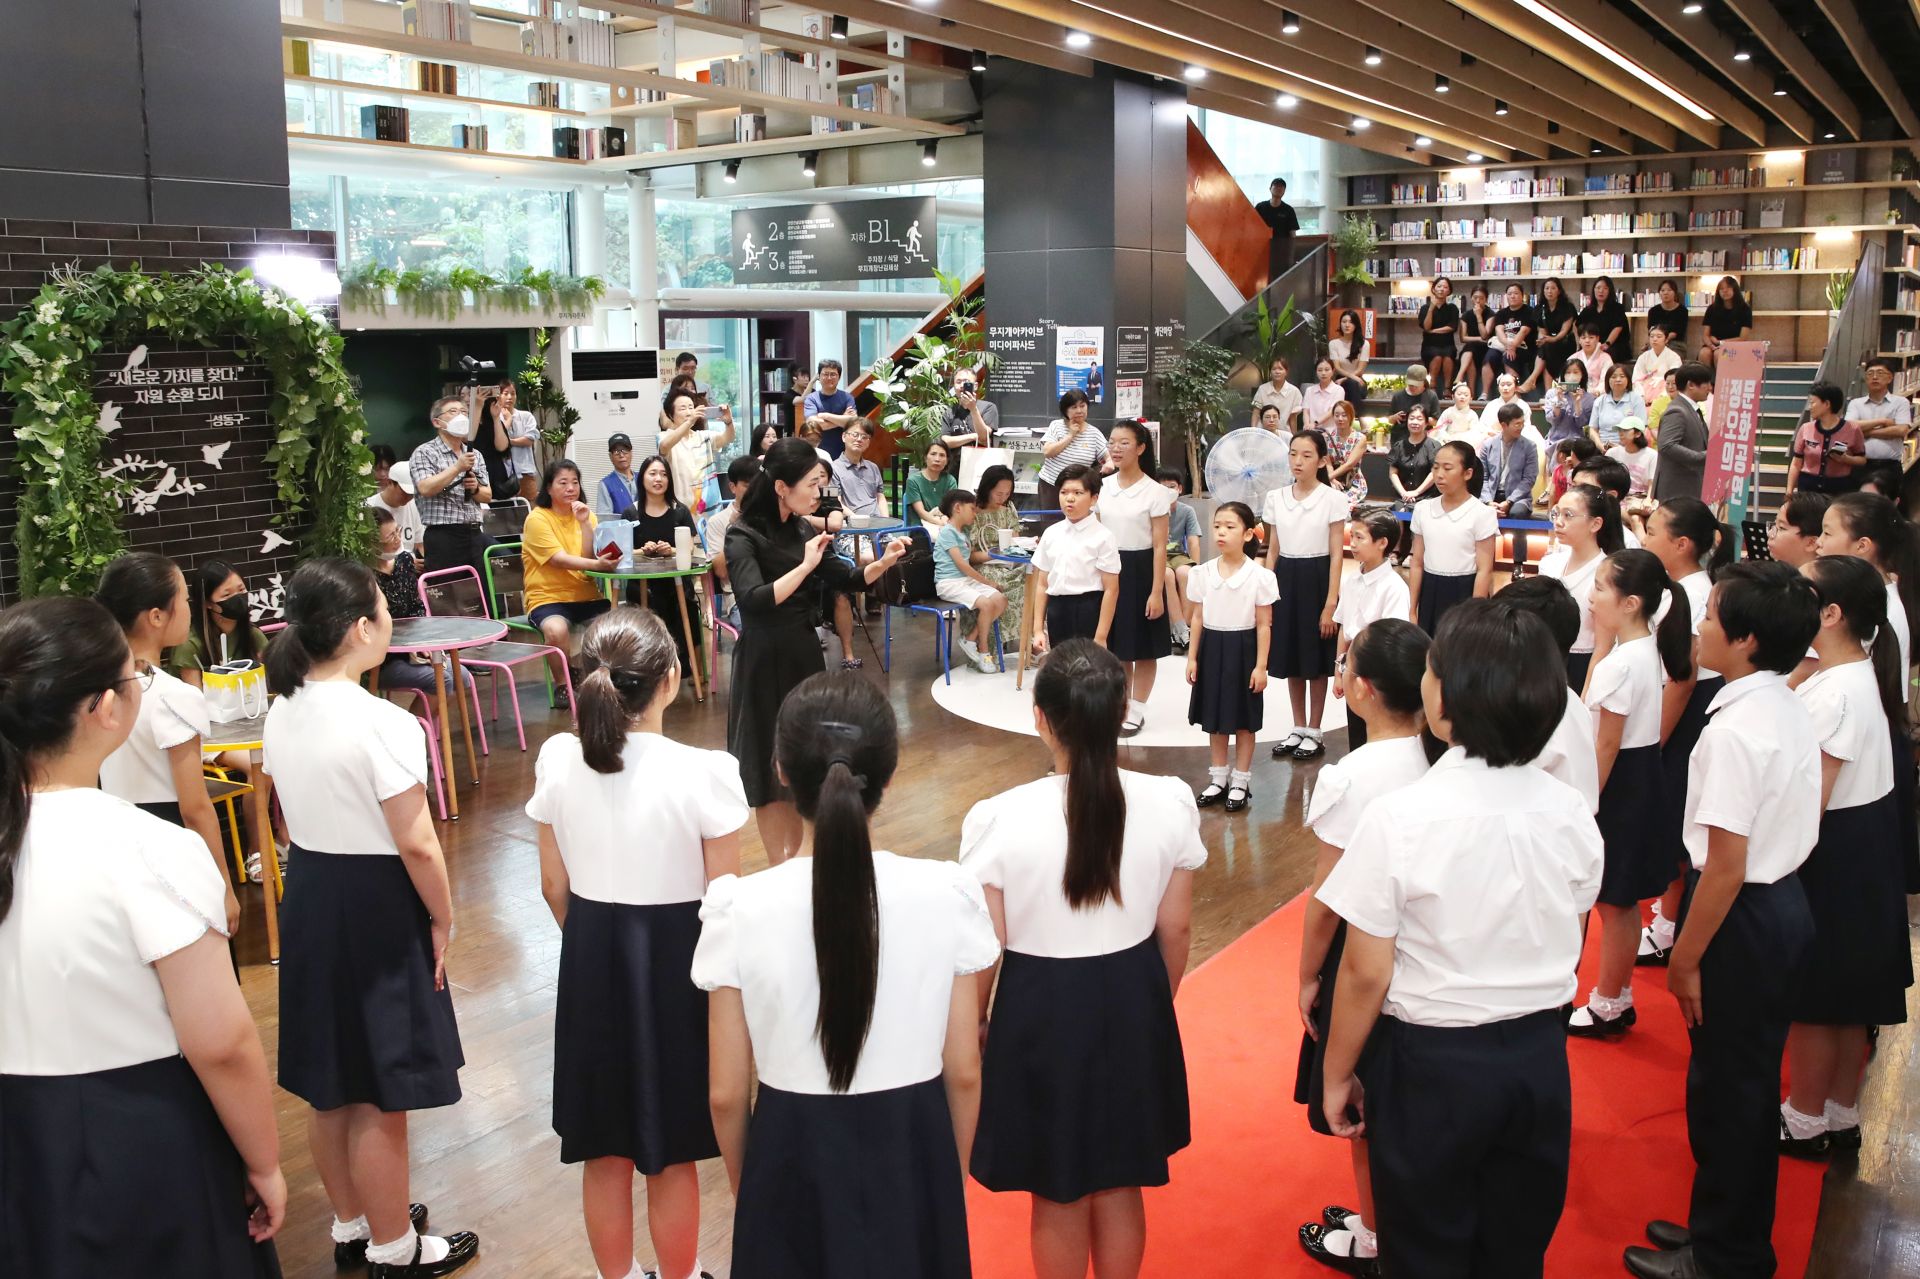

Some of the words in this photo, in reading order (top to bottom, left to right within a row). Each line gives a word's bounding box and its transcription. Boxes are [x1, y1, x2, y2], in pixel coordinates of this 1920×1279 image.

[851, 232, 866, 243] 지하
[868, 219, 890, 243] B1
[989, 327, 1044, 337] 무지개아카이브
[989, 340, 1036, 351] 미디어파사드
[163, 368, 205, 383] 가치를
[134, 389, 163, 404] 자원
[166, 387, 195, 403] 순환
[197, 386, 224, 400] 도시
[1720, 379, 1743, 471] 정오의
[1730, 379, 1756, 506] 문화공연
